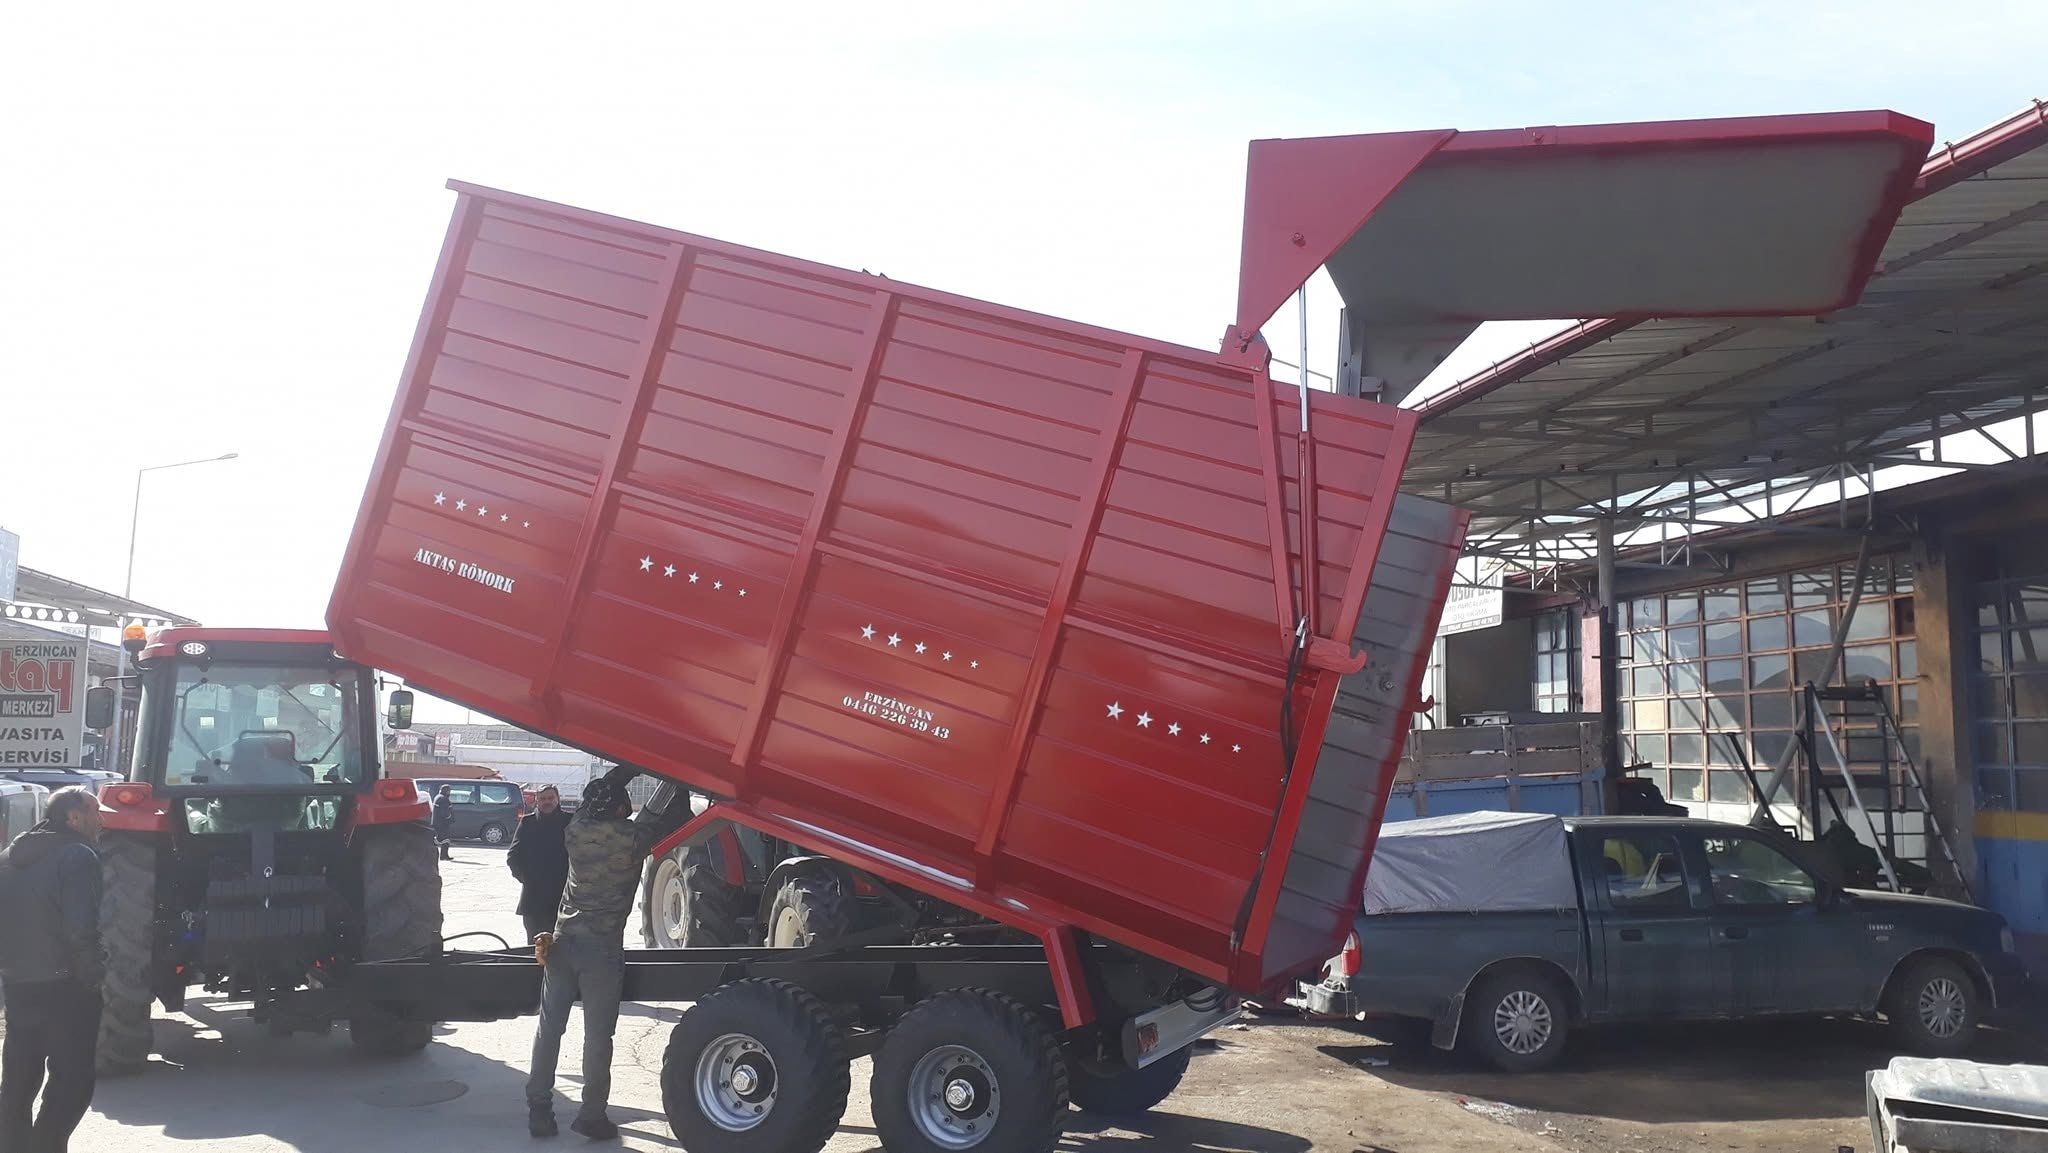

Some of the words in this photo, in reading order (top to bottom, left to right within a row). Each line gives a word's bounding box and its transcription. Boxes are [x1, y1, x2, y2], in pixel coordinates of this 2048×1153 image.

[413, 548, 456, 575] AKTAŞ
[457, 563, 515, 593] RÖMORK
[15, 643, 77, 657] ERZİNCAN
[2, 698, 52, 716] MERKEZİ
[864, 691, 934, 720] ERZİNCAN
[843, 696, 877, 715] 0446
[880, 708, 906, 725] 226
[909, 718, 928, 732] 39
[931, 726, 950, 739] 43
[0, 748, 68, 764] ERVİSİ
